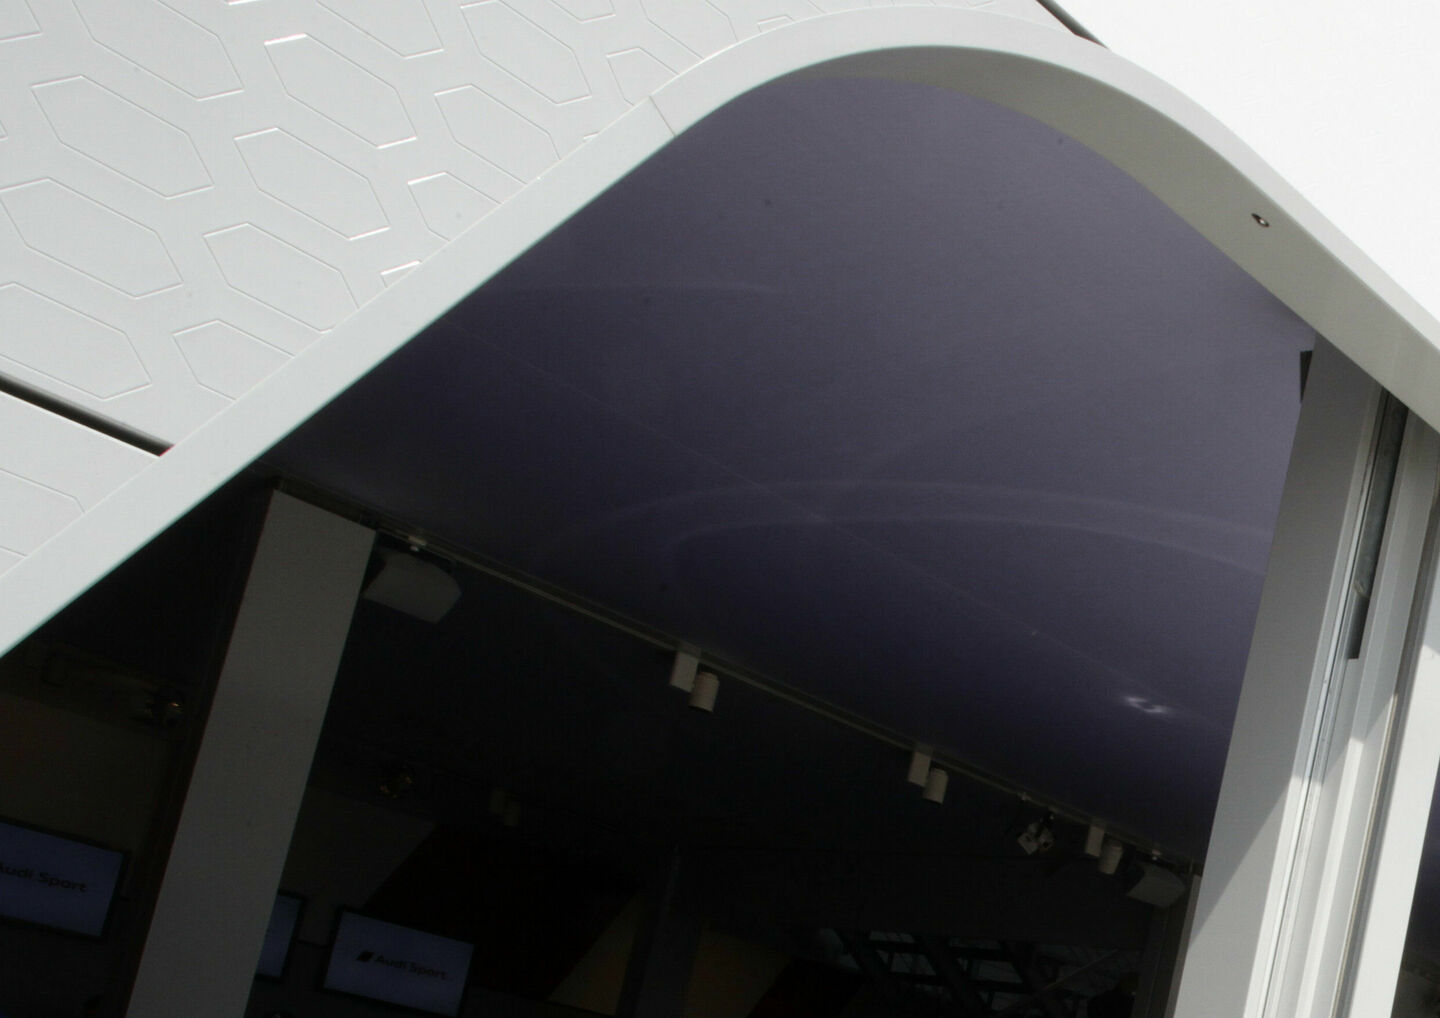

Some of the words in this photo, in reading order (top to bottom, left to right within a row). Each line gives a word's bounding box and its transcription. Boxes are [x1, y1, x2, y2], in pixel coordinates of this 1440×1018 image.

[39, 871, 87, 893] Sport
[375, 954, 408, 970] Audi
[409, 962, 447, 981] Sport
